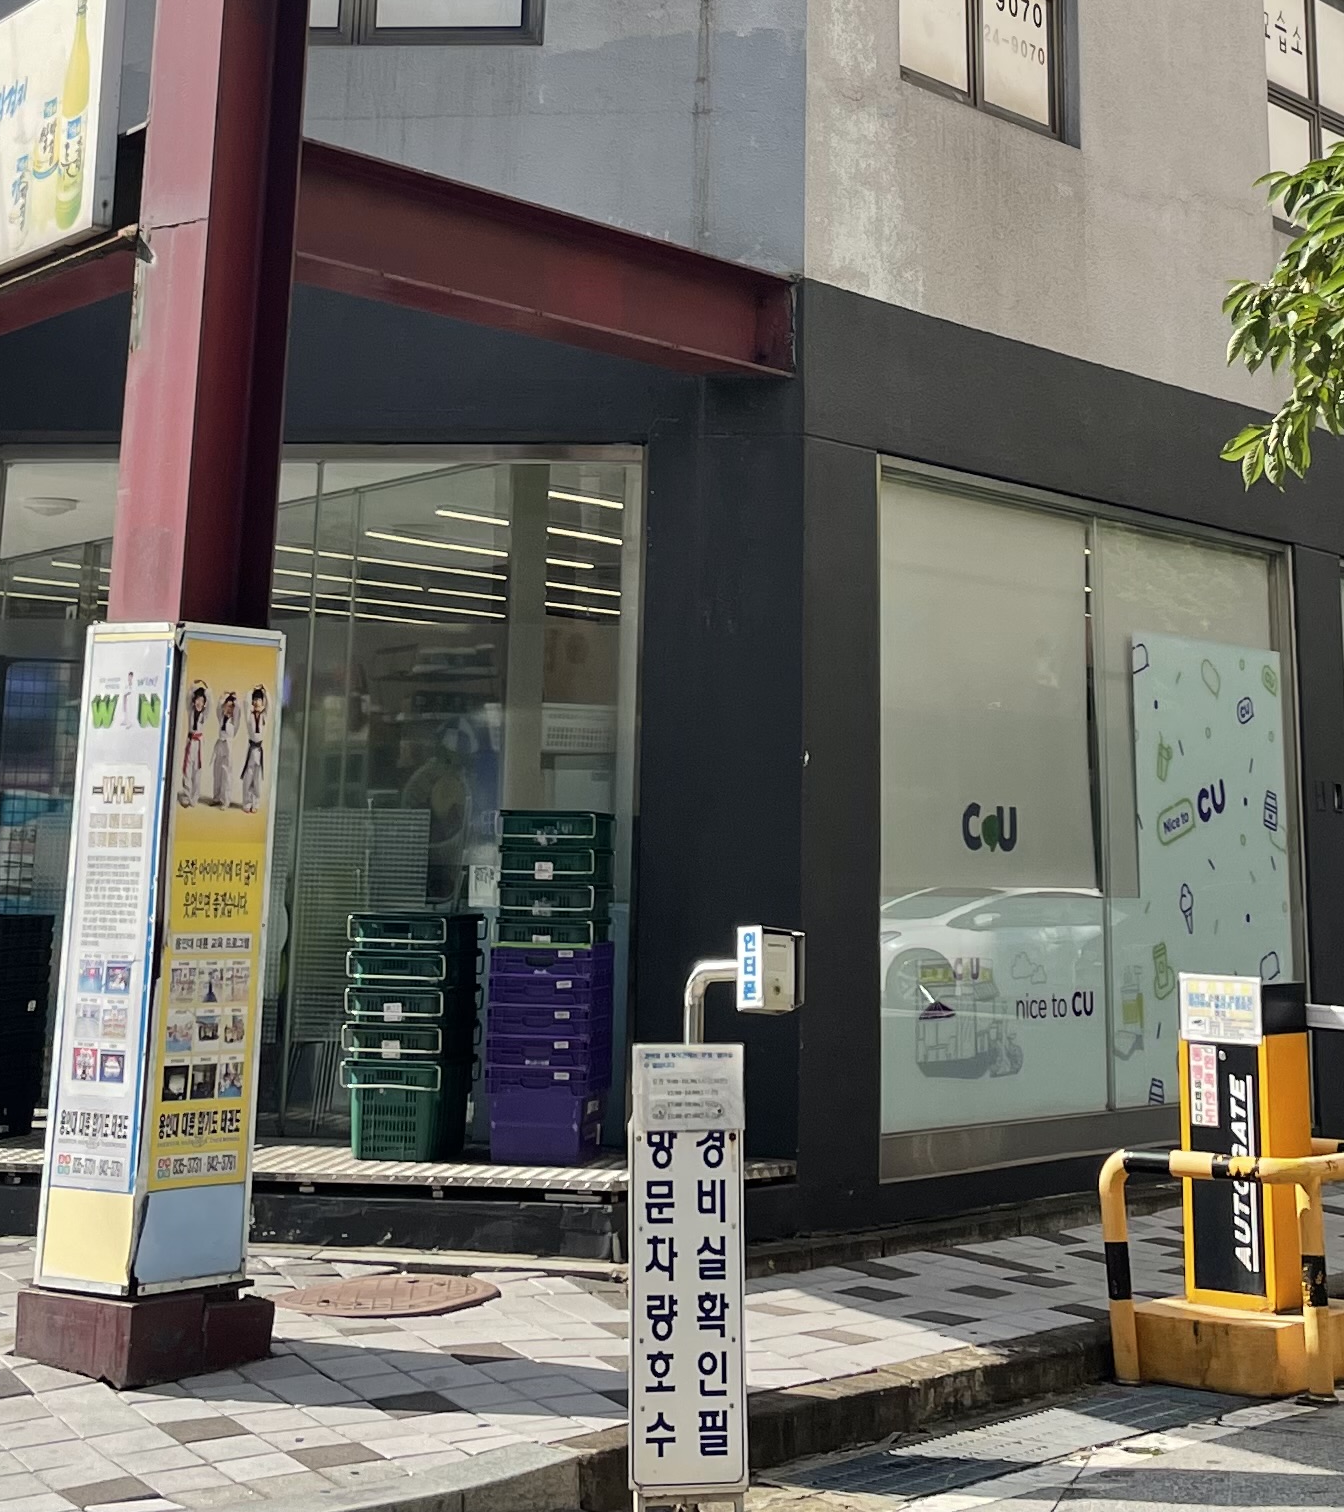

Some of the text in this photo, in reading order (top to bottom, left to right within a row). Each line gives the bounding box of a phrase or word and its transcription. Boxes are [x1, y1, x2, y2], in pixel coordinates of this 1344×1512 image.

[962, 802, 1018, 852] CU
[1163, 779, 1226, 835] Nice to CU
[1015, 991, 1094, 1020] nice to CU
[695, 1130, 730, 1458] 경비실확인필
